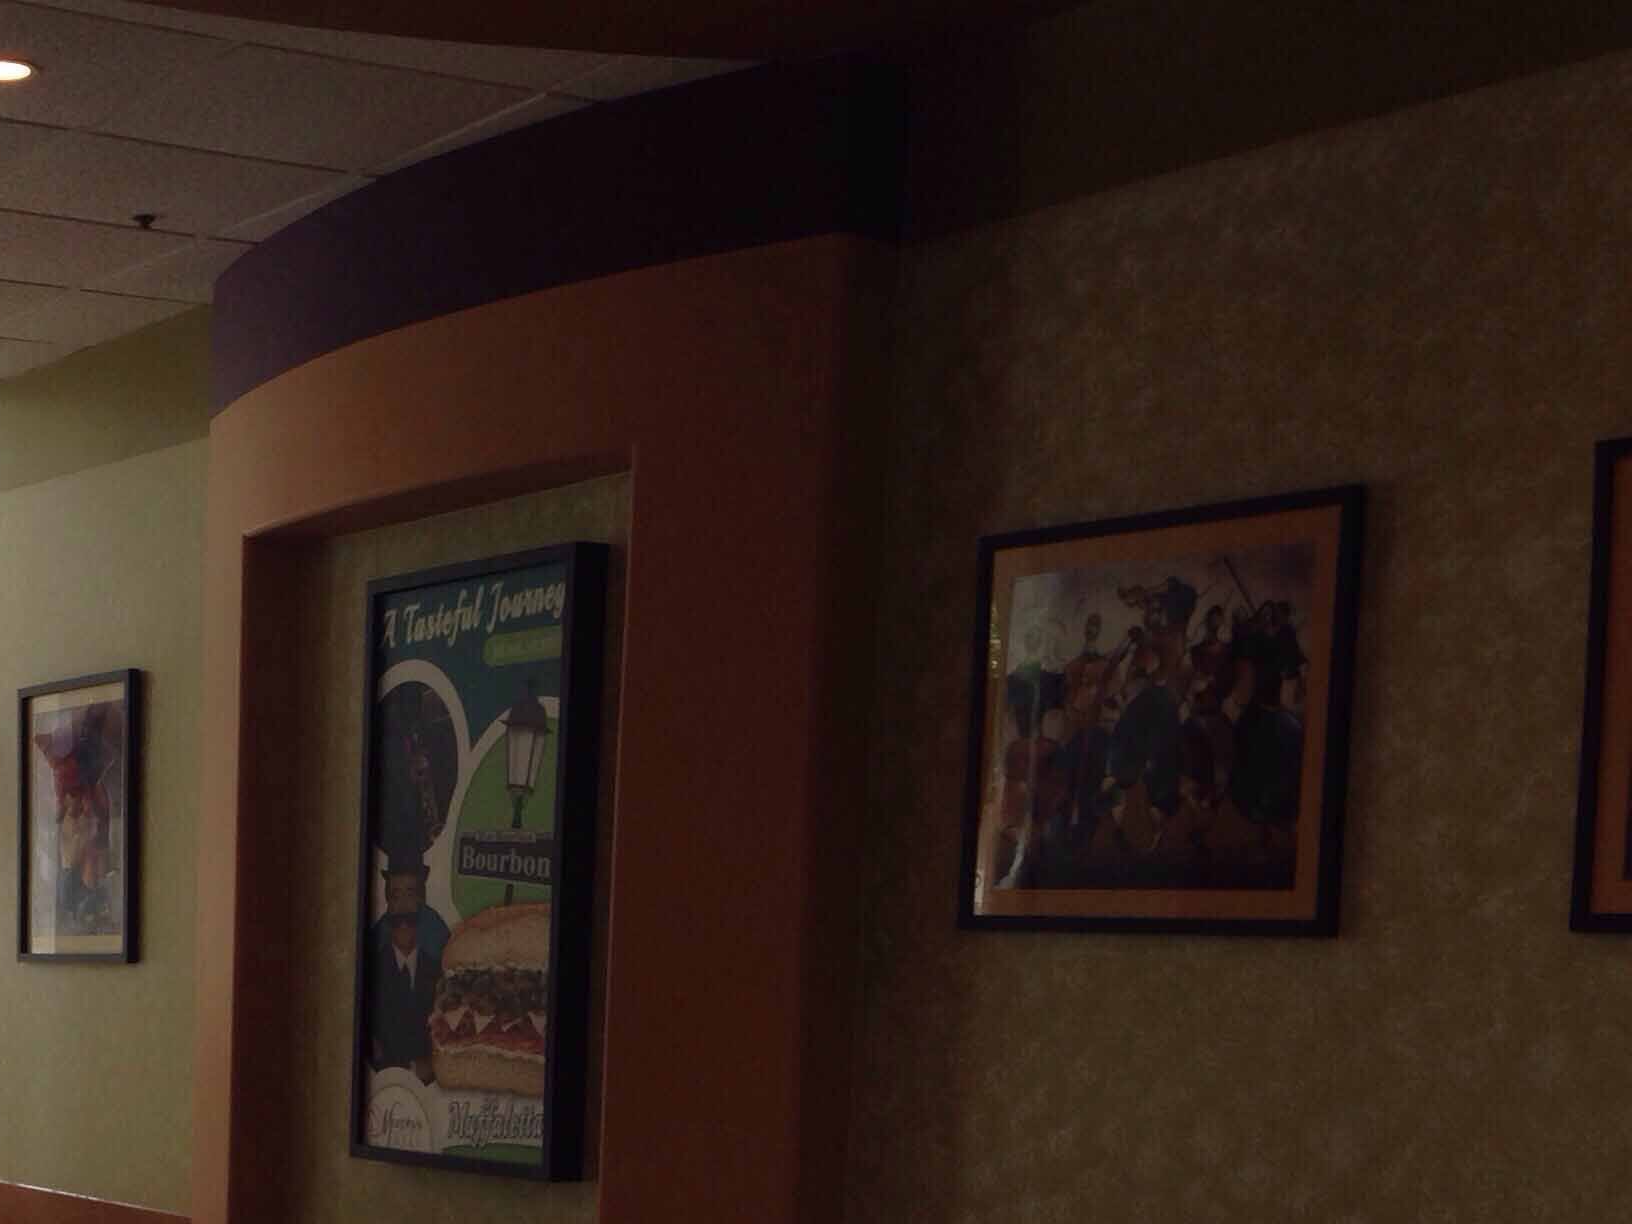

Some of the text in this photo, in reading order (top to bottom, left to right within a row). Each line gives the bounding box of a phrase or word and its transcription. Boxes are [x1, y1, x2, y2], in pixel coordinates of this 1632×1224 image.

[383, 577, 566, 648] A Tasteful Journey
[463, 846, 552, 877] Bourbon
